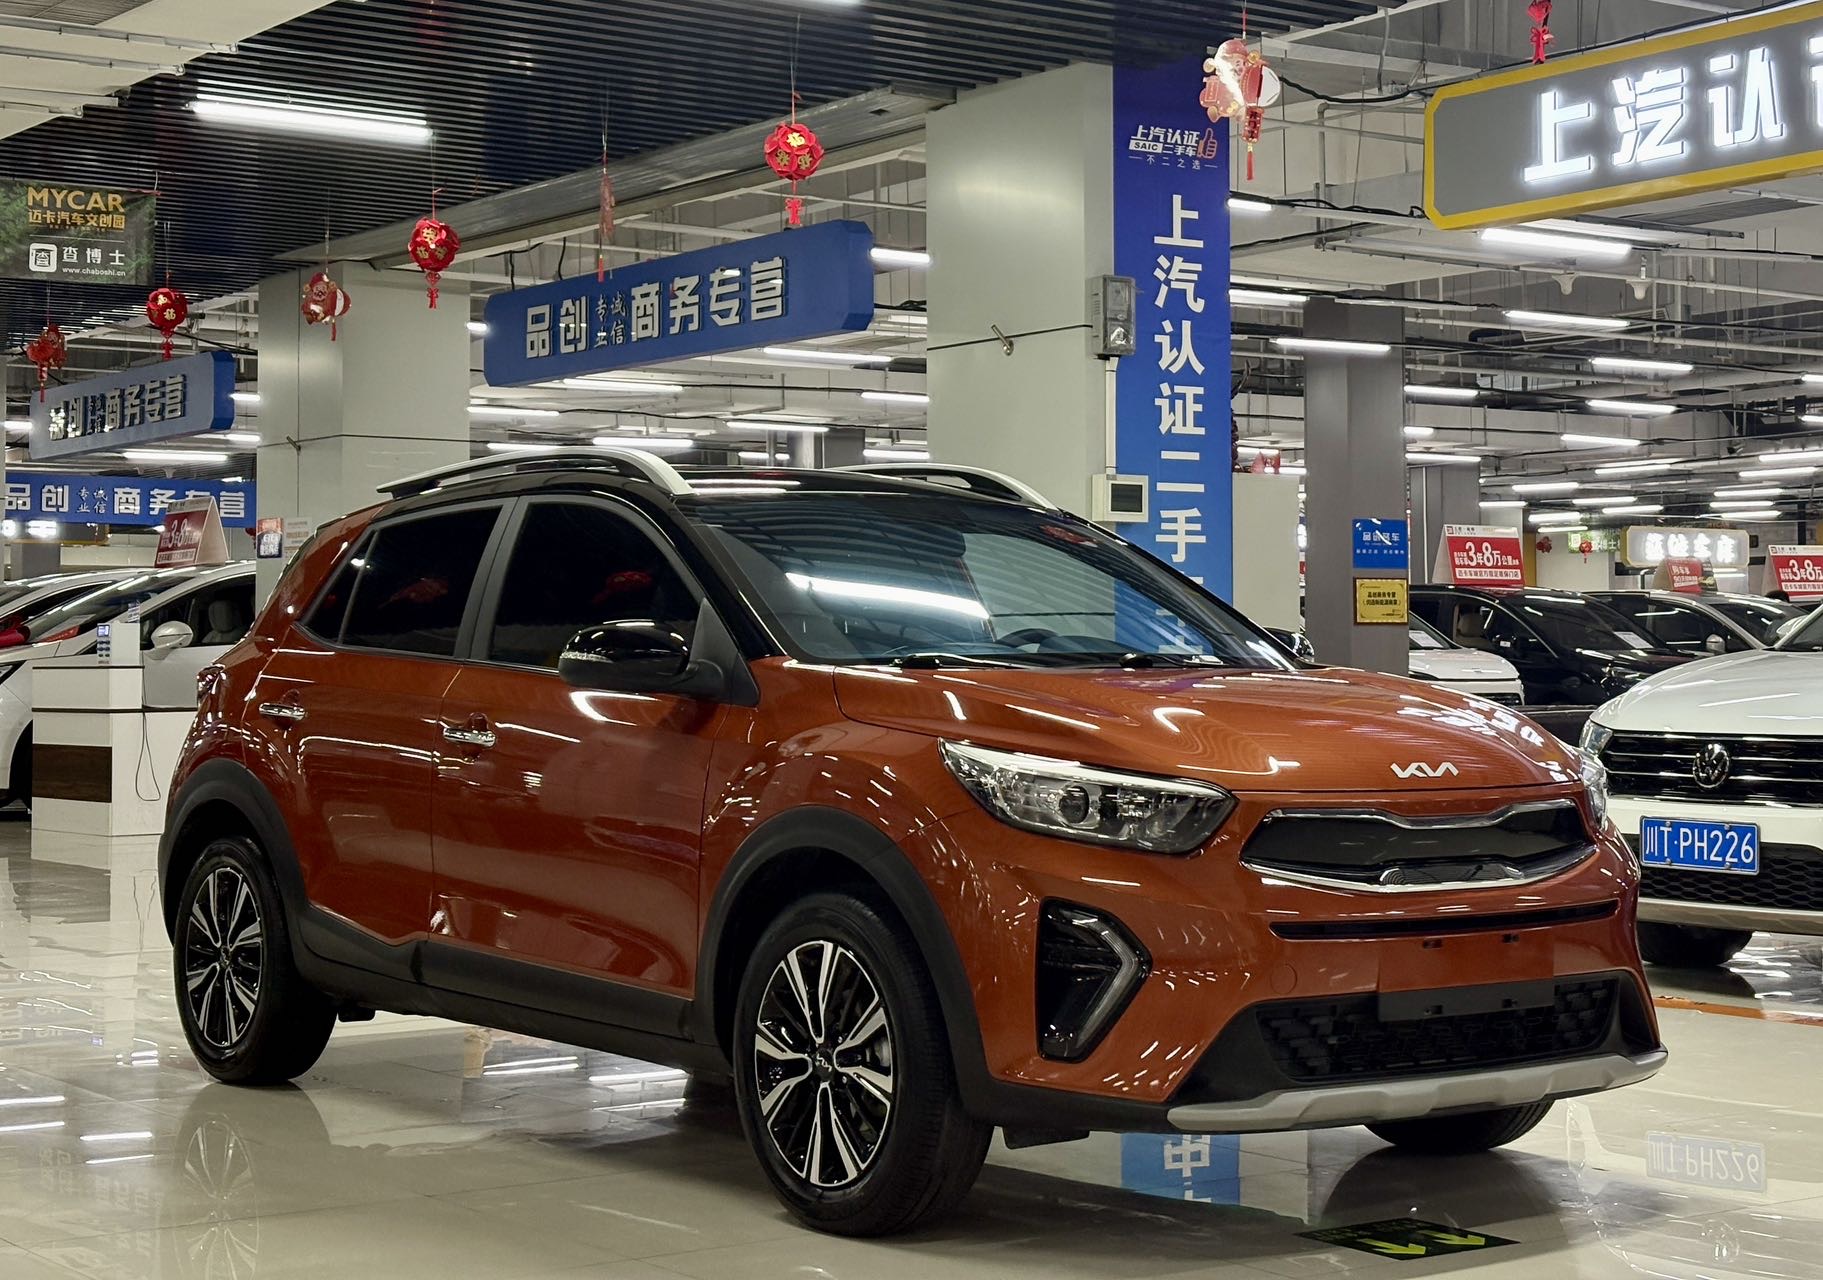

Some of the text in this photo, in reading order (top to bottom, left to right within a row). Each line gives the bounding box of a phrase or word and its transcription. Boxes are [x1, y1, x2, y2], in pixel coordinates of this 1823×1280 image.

[1523, 36, 1823, 183] 上汽认
[1131, 125, 1200, 146] 上汽认证
[1134, 142, 1158, 151] SAIC
[1163, 144, 1198, 157] 二手车
[1146, 155, 1200, 170] 不二之选
[27, 186, 125, 212] MYCAR
[28, 209, 126, 229] 迈卡汽车文创园
[62, 246, 125, 266] 查博士
[62, 267, 126, 276] www.chaboshi.cn
[526, 296, 588, 358] 品创
[631, 257, 784, 342] 商务专营
[1154, 195, 1207, 590] 上汽认证二手
[6, 483, 70, 512] 品创
[1390, 762, 1459, 778] KIA
